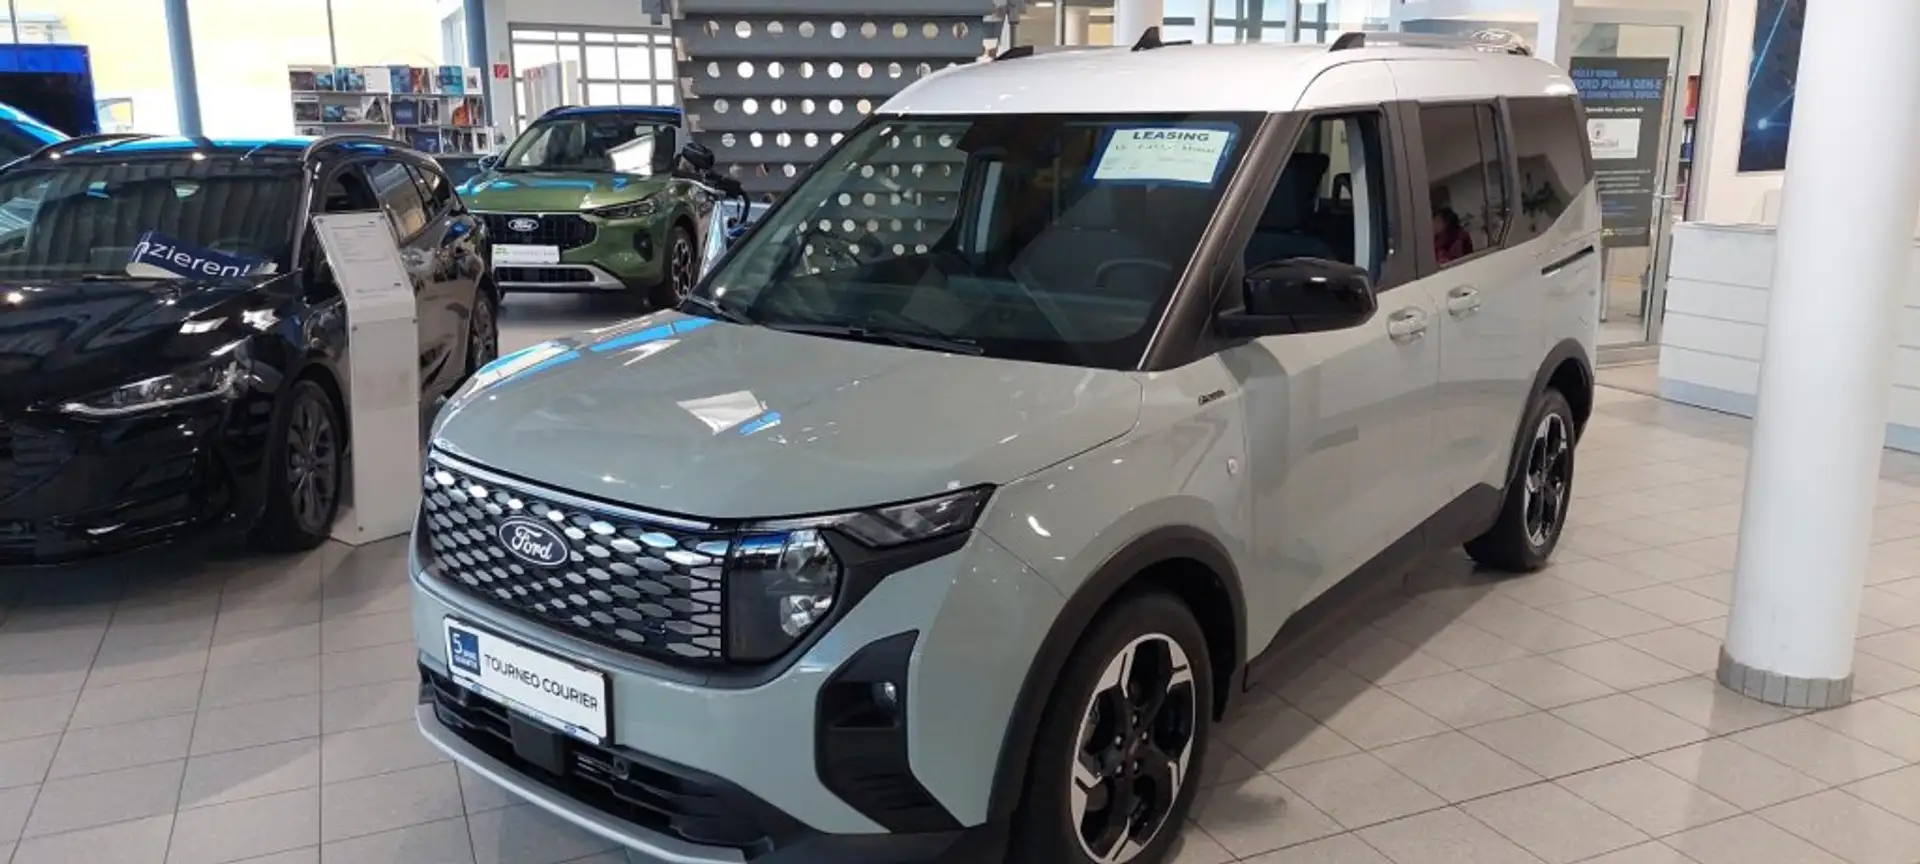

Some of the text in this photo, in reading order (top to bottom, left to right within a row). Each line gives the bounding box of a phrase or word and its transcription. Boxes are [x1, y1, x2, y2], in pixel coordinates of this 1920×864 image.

[1600, 78, 1631, 90] PUMA
[1133, 131, 1210, 142] LEASING
[511, 526, 553, 560] Ford
[452, 632, 463, 654] 5
[484, 654, 599, 711] TOURNEO COURIER
